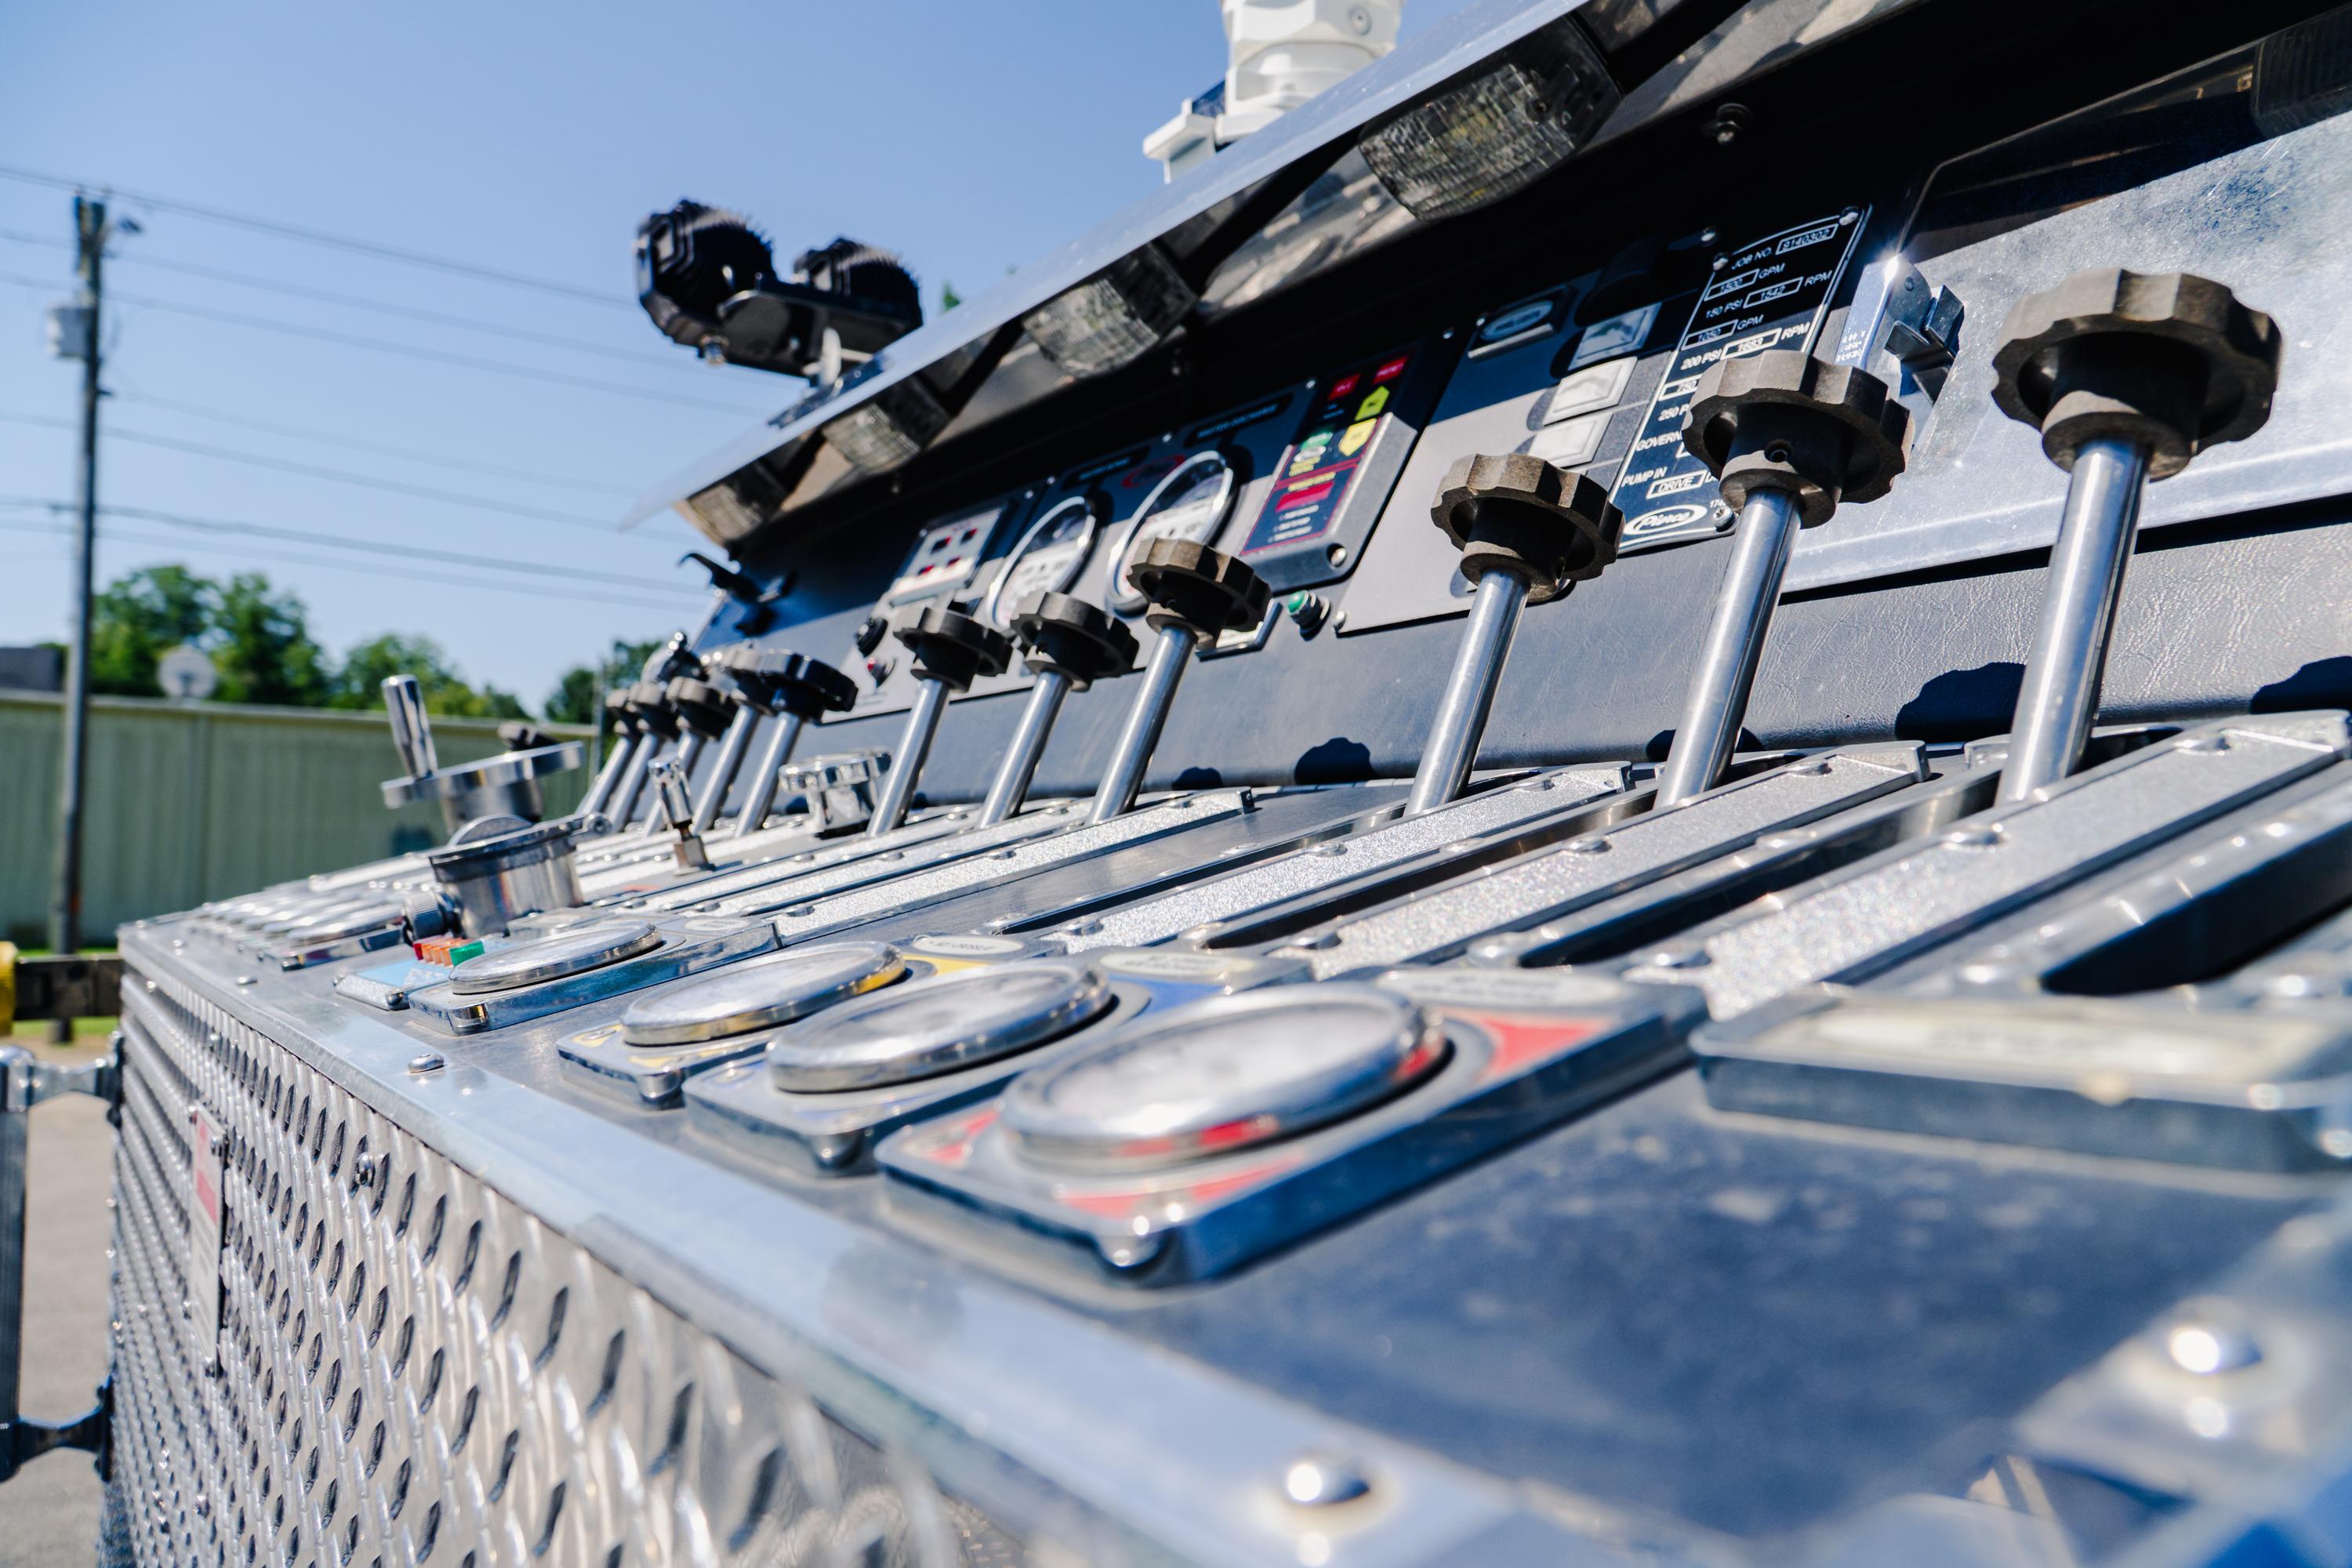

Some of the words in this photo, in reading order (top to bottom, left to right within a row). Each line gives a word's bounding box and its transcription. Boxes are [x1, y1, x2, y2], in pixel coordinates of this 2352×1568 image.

[1731, 254, 1753, 270] JOB
[1759, 262, 1786, 279] GPM
[1705, 306, 1723, 319] 150
[1724, 299, 1744, 312] PSI
[1804, 270, 1833, 288] RPM
[1737, 314, 1764, 331] GPM
[1680, 355, 1702, 371] 200
[1702, 349, 1723, 364] PSI
[1781, 321, 1811, 341] RPM
[1636, 430, 1683, 452] GOVERN
[1621, 470, 1654, 488] PUMP
[1653, 466, 1668, 479] IN
[1657, 476, 1695, 493] DRIVE
